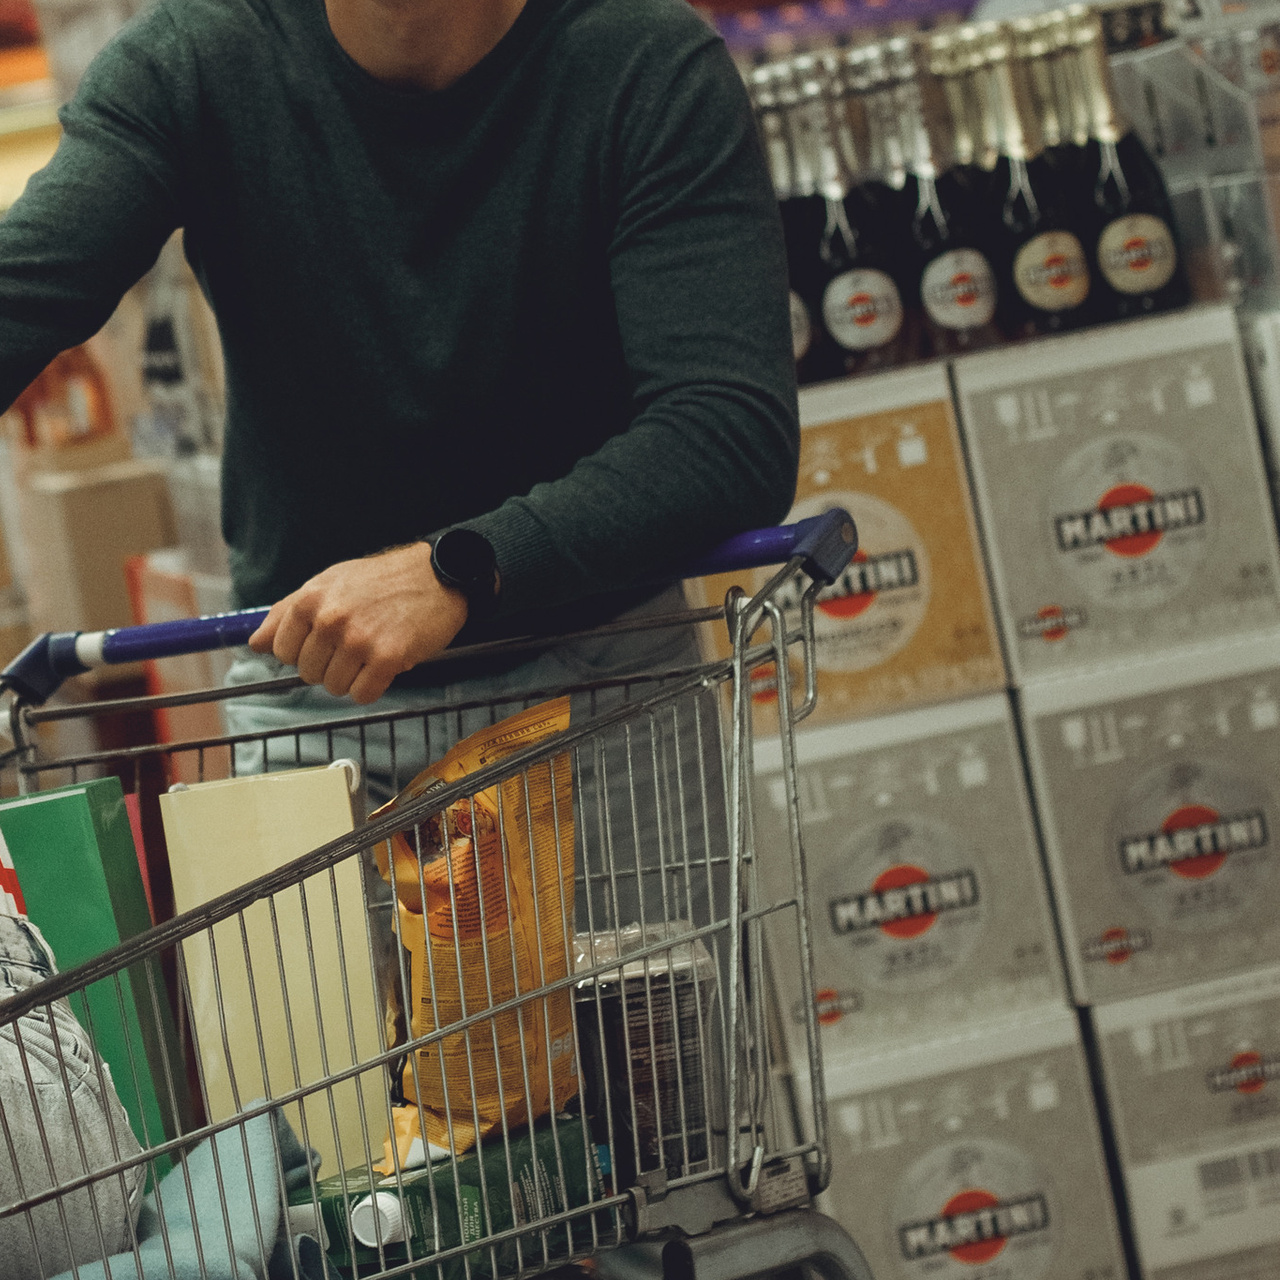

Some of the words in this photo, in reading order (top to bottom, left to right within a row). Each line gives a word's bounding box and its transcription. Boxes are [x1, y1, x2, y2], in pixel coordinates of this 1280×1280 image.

[1058, 493, 1201, 546] MARTINI
[1124, 816, 1263, 868] MARTINI
[833, 876, 973, 931] MARTINI
[904, 1199, 1045, 1254] MARTINI
